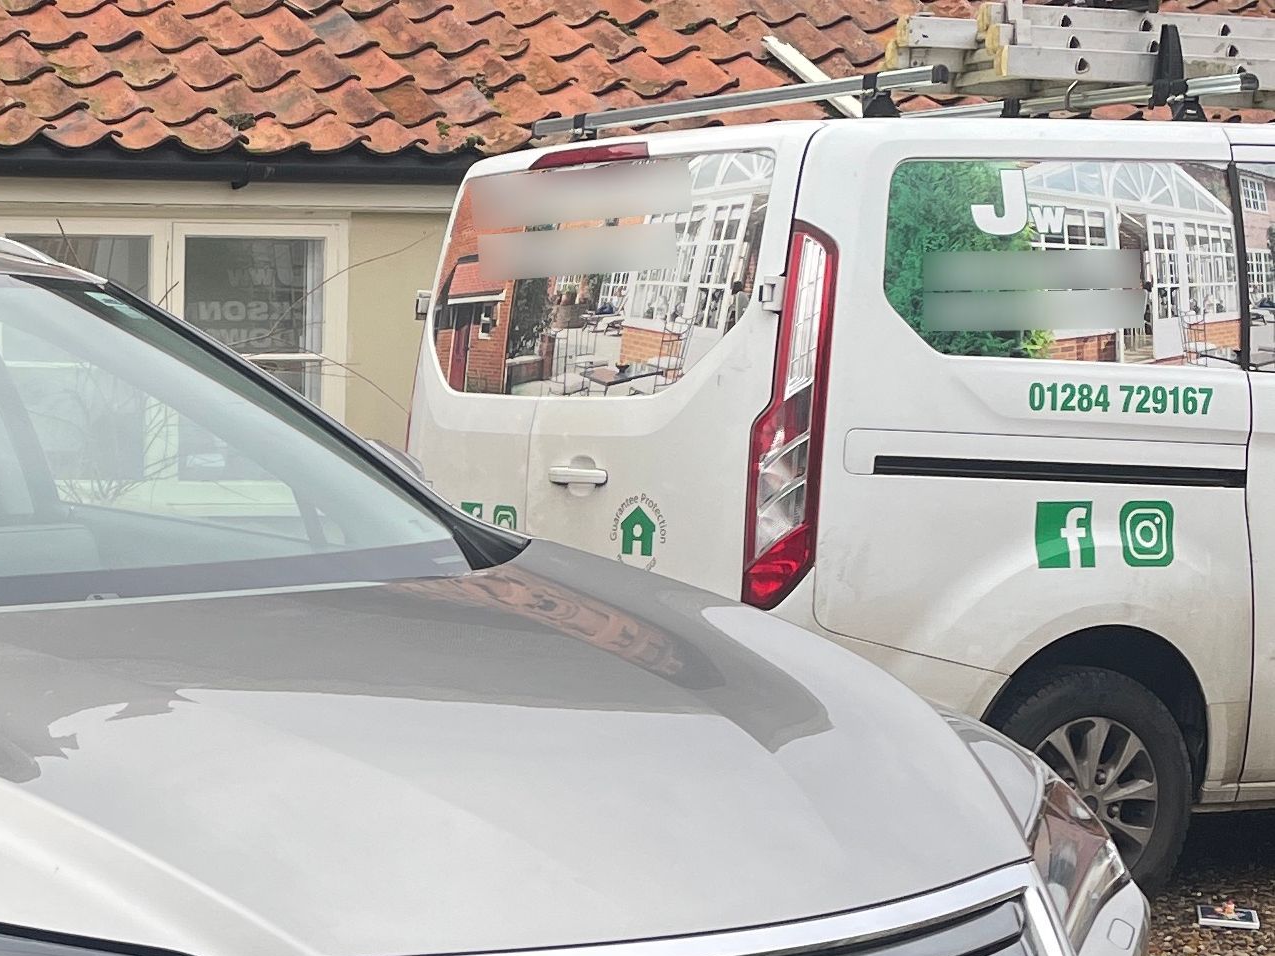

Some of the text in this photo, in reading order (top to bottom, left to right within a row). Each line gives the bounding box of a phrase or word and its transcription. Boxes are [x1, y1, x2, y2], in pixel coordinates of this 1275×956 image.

[1028, 382, 1214, 415] 01284 729167
[609, 492, 668, 544] Guarantee Protection
